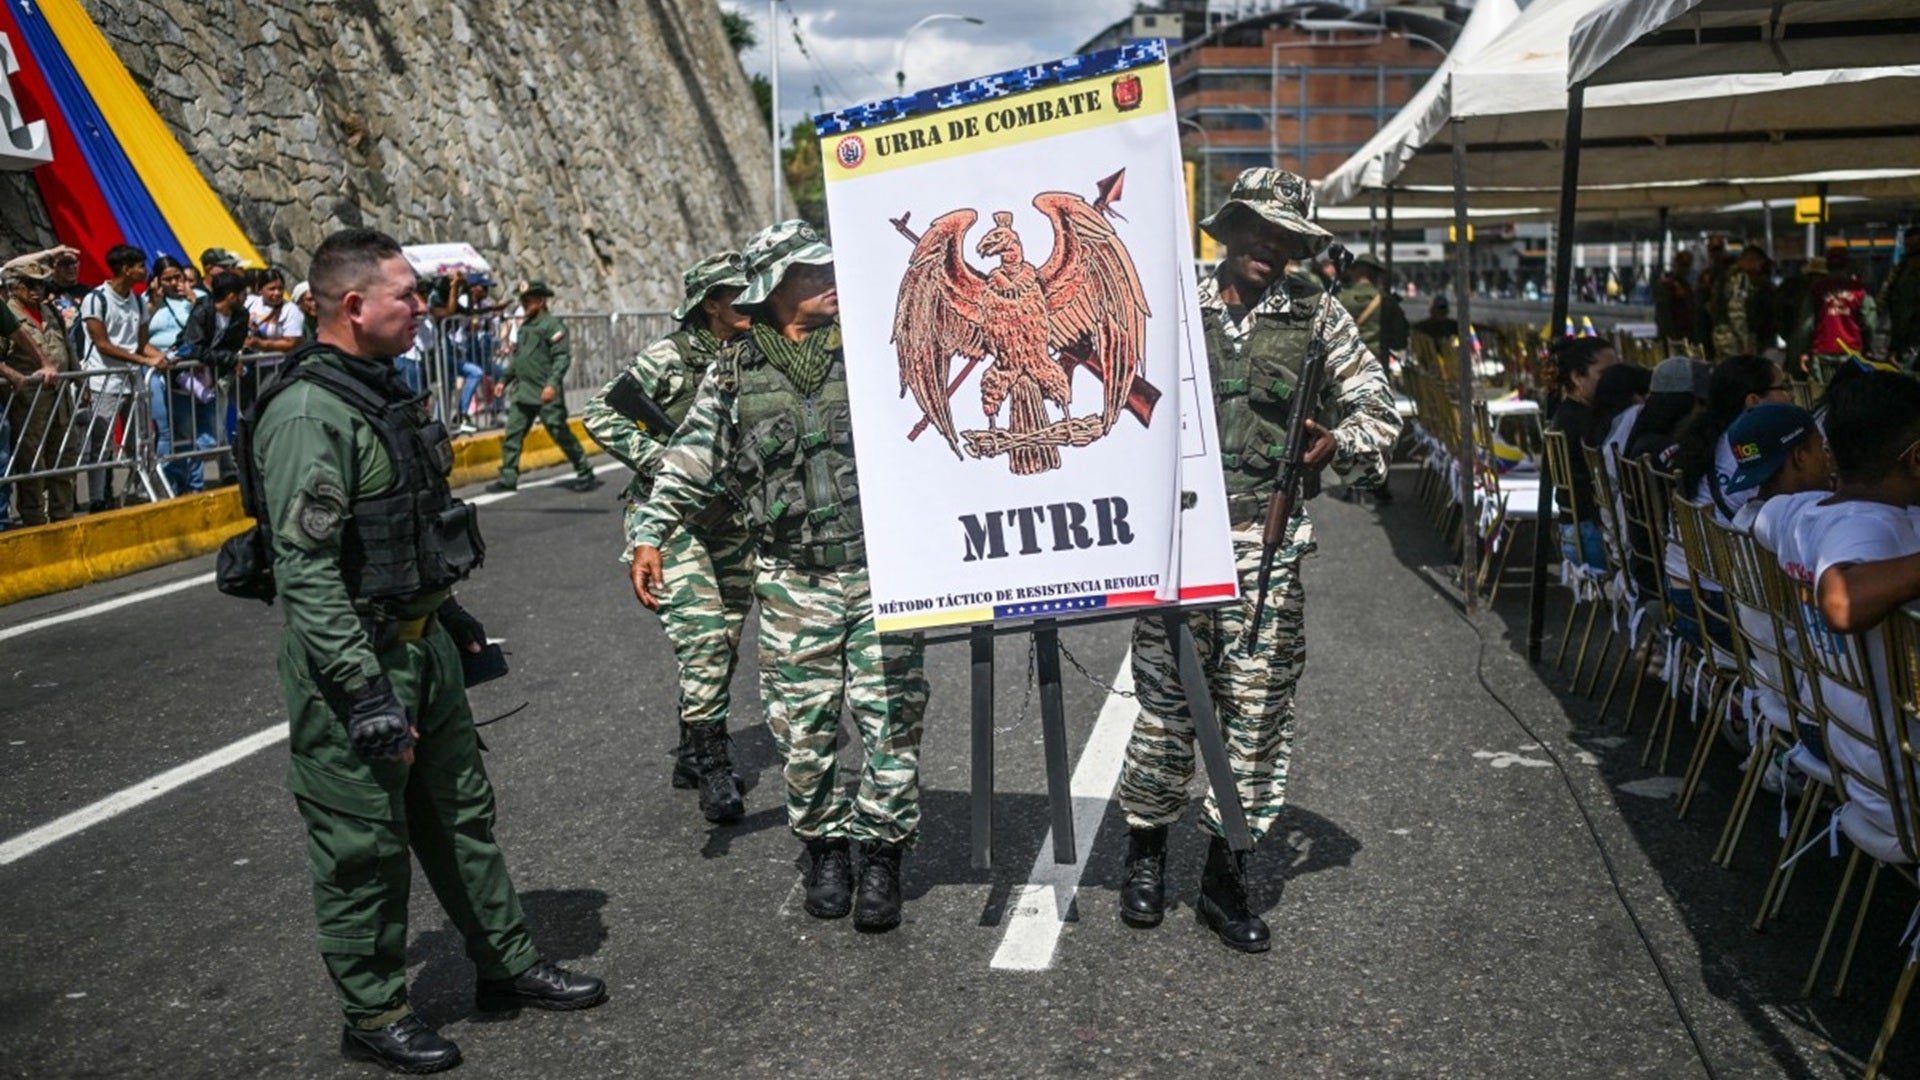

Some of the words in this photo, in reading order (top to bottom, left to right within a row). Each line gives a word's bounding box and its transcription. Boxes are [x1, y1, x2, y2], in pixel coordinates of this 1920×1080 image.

[875, 124, 942, 157] URRA
[947, 116, 980, 142] DE
[985, 89, 1102, 133] COMBATE
[958, 496, 1135, 562] MTRR
[878, 598, 933, 615] MÉTODO
[936, 591, 993, 608] TÁCTICO
[995, 588, 1014, 601] DE
[1016, 580, 1101, 600] RESISTENCIA
